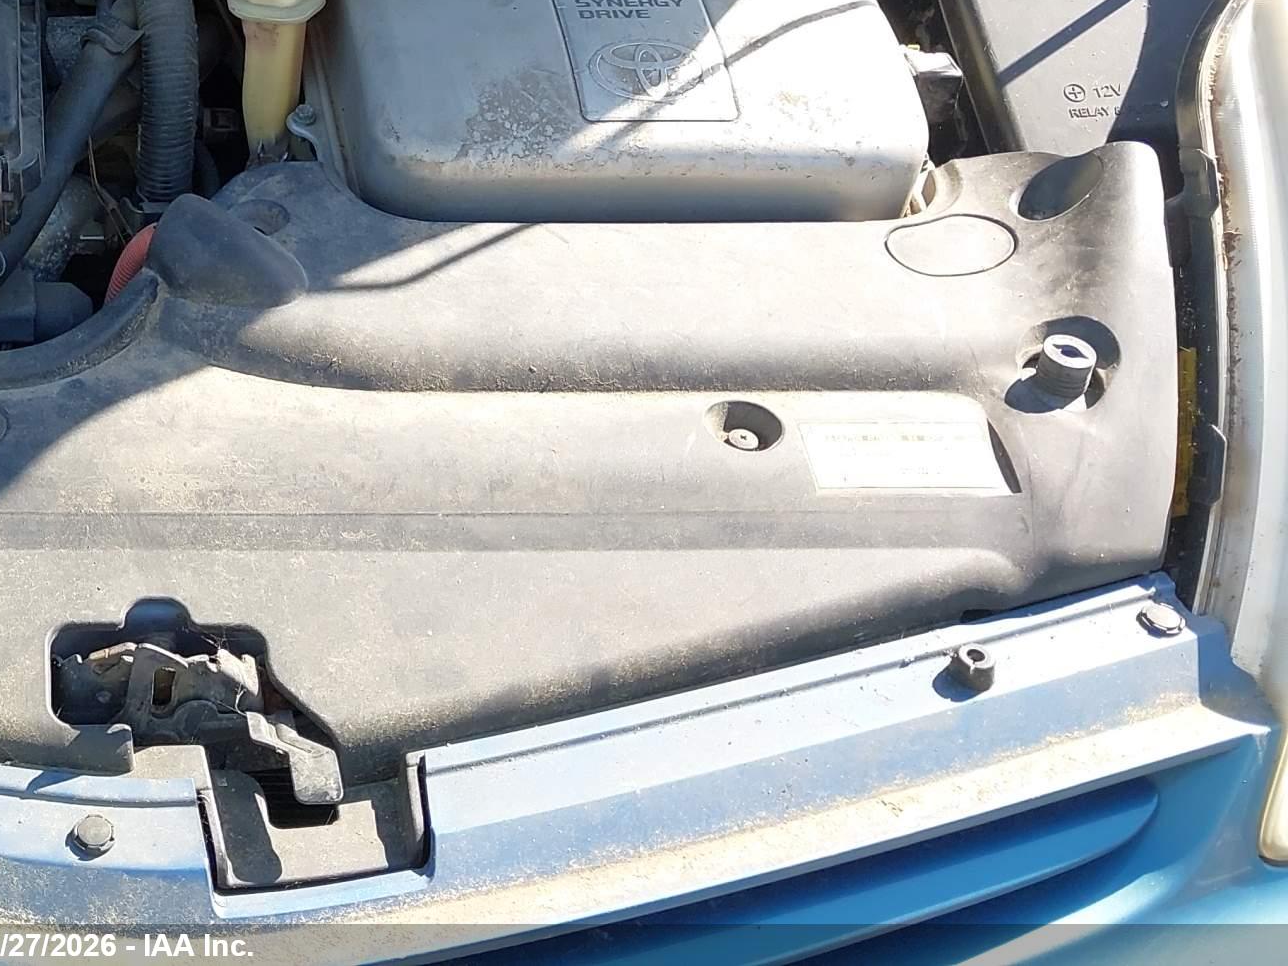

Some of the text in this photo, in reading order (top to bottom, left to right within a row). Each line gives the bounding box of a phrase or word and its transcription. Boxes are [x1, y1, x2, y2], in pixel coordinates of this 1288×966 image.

[579, 9, 651, 20] DRIVE
[1092, 83, 1121, 98] 12V
[1068, 106, 1109, 118] RELAY
